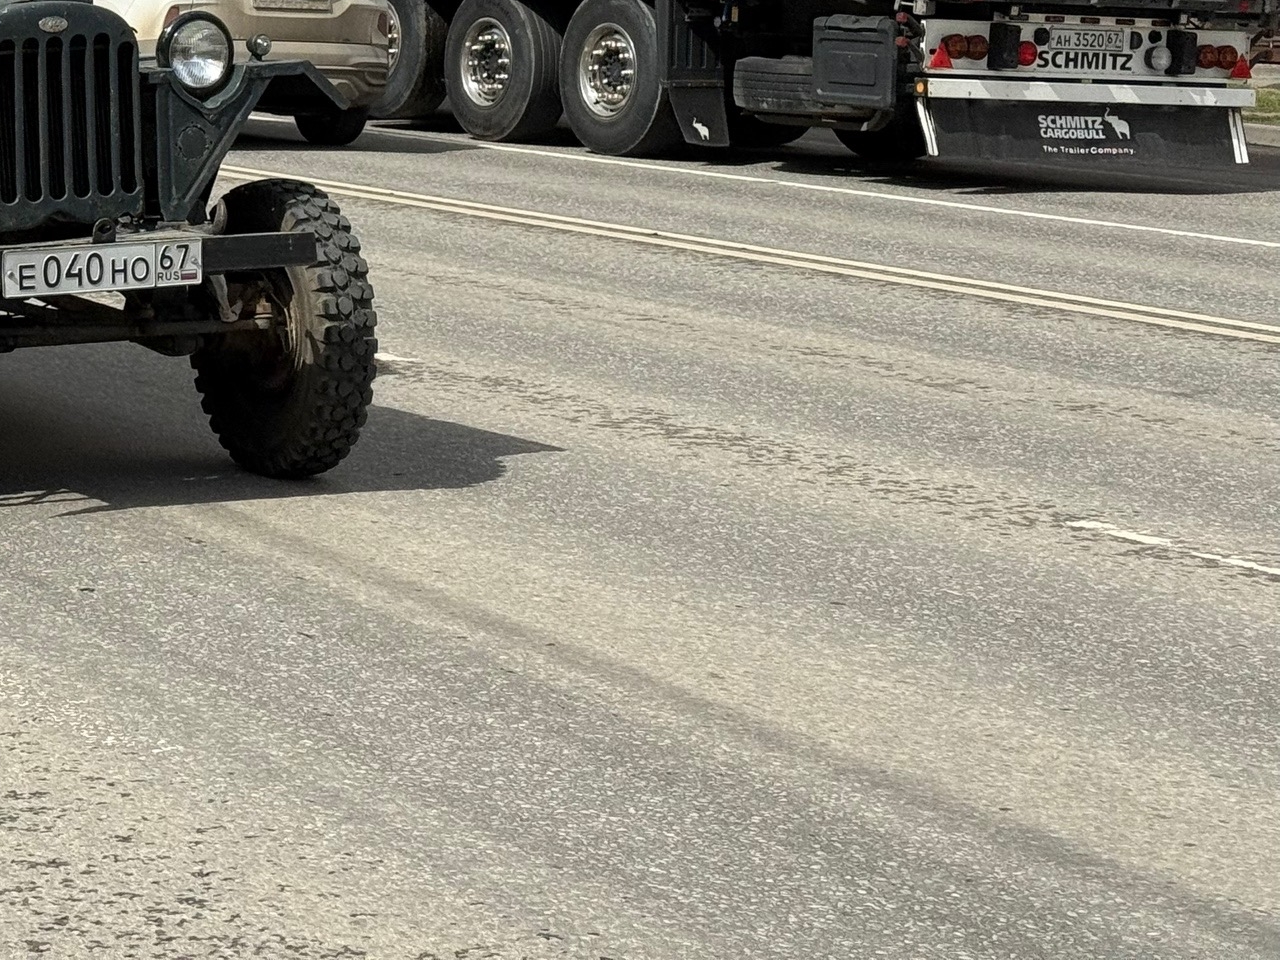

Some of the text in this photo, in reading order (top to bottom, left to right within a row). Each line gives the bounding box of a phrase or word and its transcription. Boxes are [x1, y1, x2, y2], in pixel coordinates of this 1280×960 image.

[1107, 33, 1120, 44] 67
[1036, 50, 1134, 71] SCHMITZ
[1037, 114, 1104, 129] SCHMITZ
[1040, 128, 1107, 139] CARGOBULL
[1042, 145, 1058, 153] The
[159, 243, 190, 271] 67
[157, 271, 180, 282] RUS
